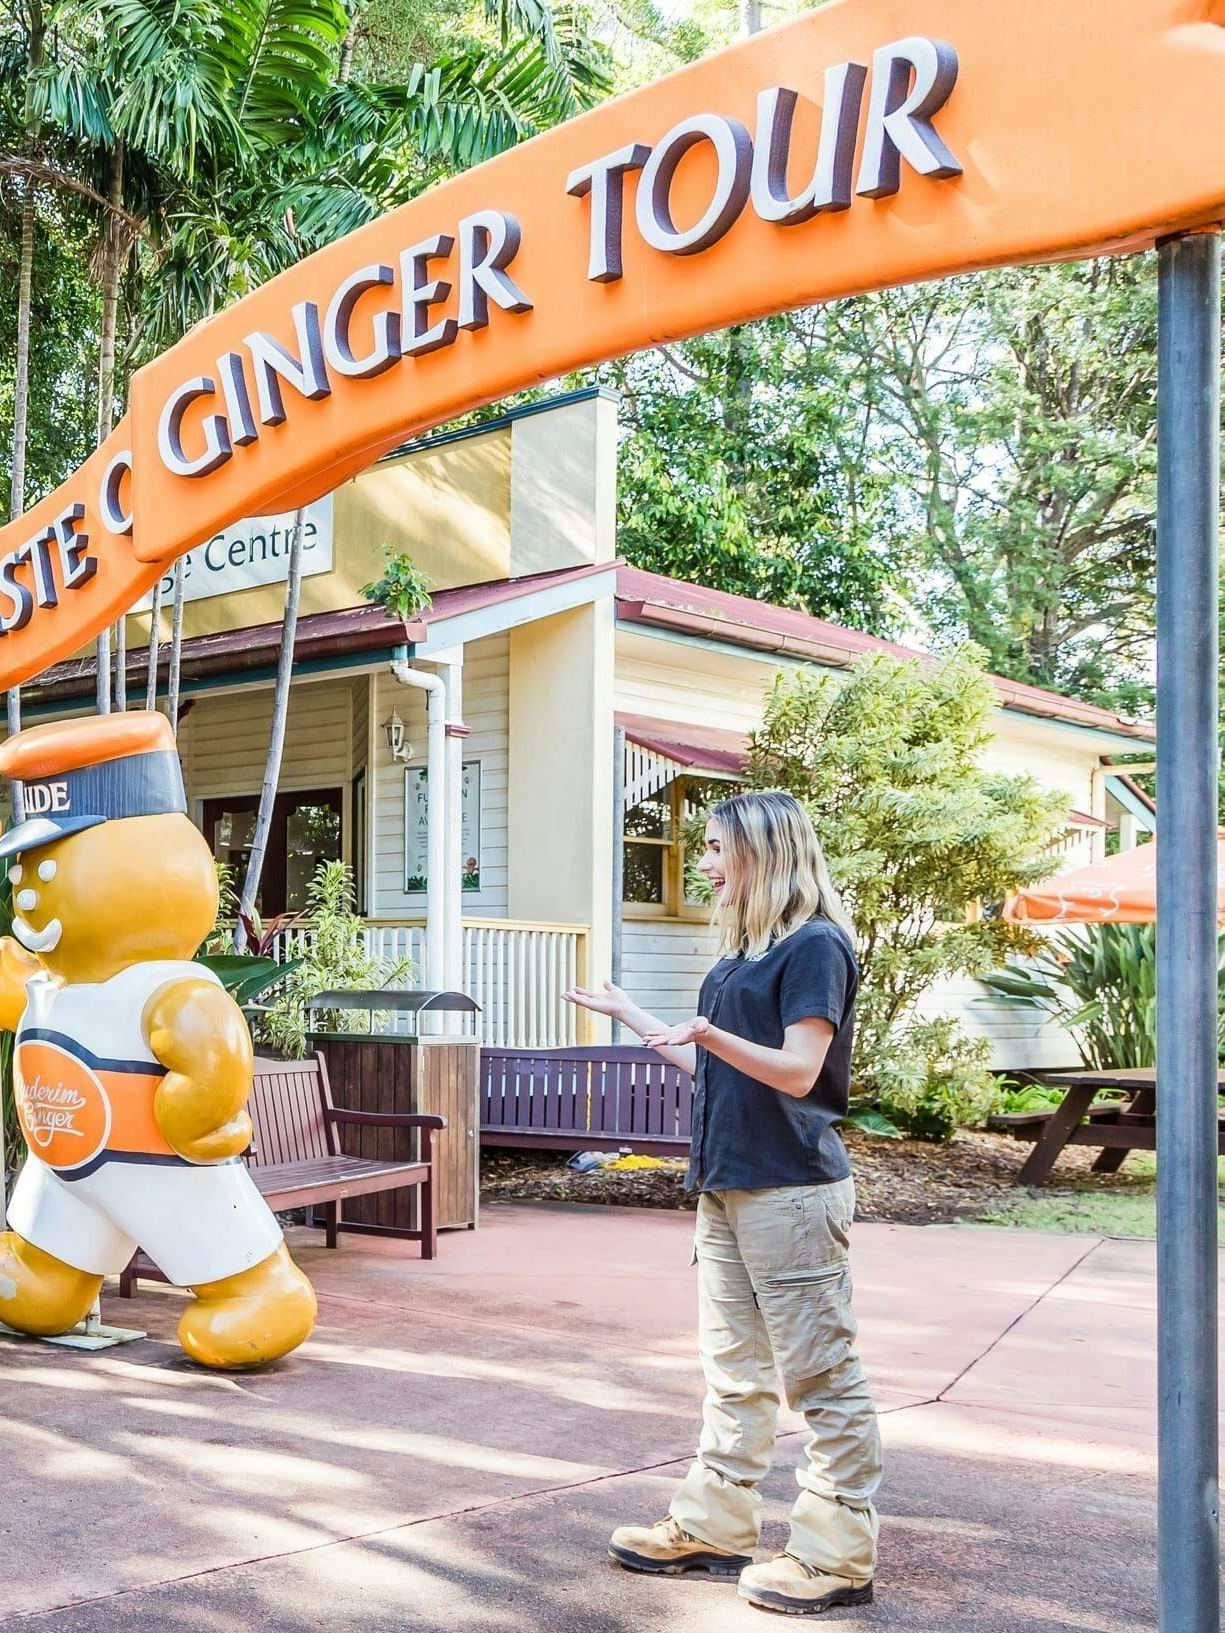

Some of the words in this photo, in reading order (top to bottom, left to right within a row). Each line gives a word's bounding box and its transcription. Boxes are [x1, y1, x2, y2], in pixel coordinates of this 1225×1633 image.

[157, 209, 534, 478] GINGER
[565, 36, 964, 284] TOUR
[204, 521, 318, 572] Centre
